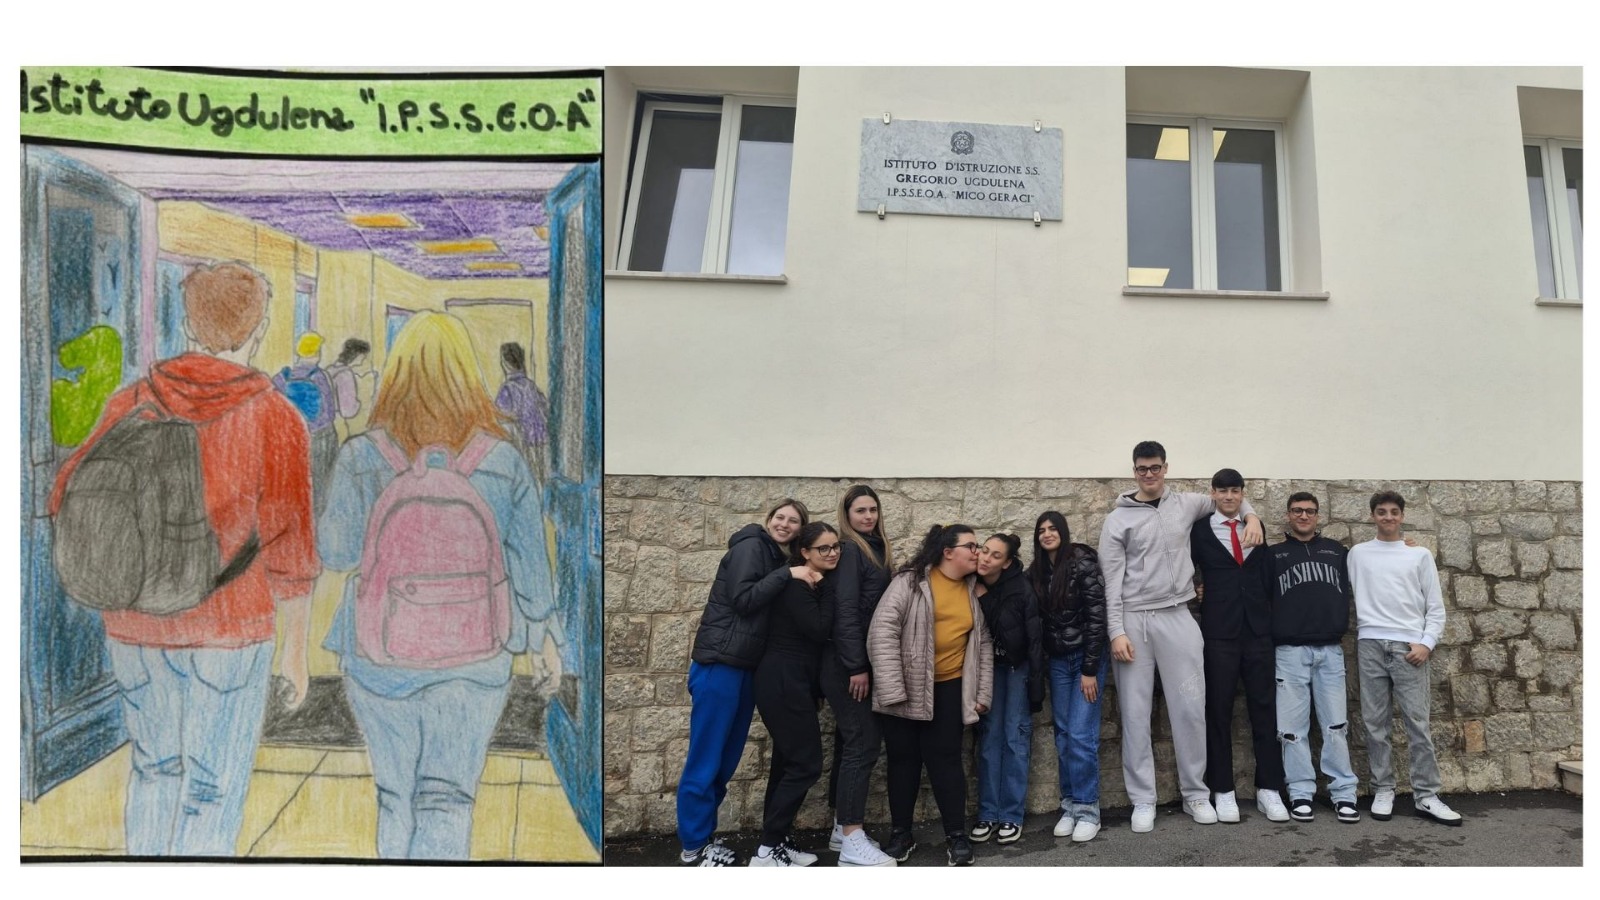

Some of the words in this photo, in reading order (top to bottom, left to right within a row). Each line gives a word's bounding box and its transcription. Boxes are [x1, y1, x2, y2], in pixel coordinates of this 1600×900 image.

[20, 69, 171, 121] Istituto
[178, 92, 354, 137] Ugdulena
[884, 159, 937, 170] ISTITUTO
[945, 162, 1022, 175] D'ISTRUZIONE
[1025, 166, 1041, 176] S.S.
[896, 174, 958, 185] GREGORIO
[964, 178, 1026, 189] UGDULENA
